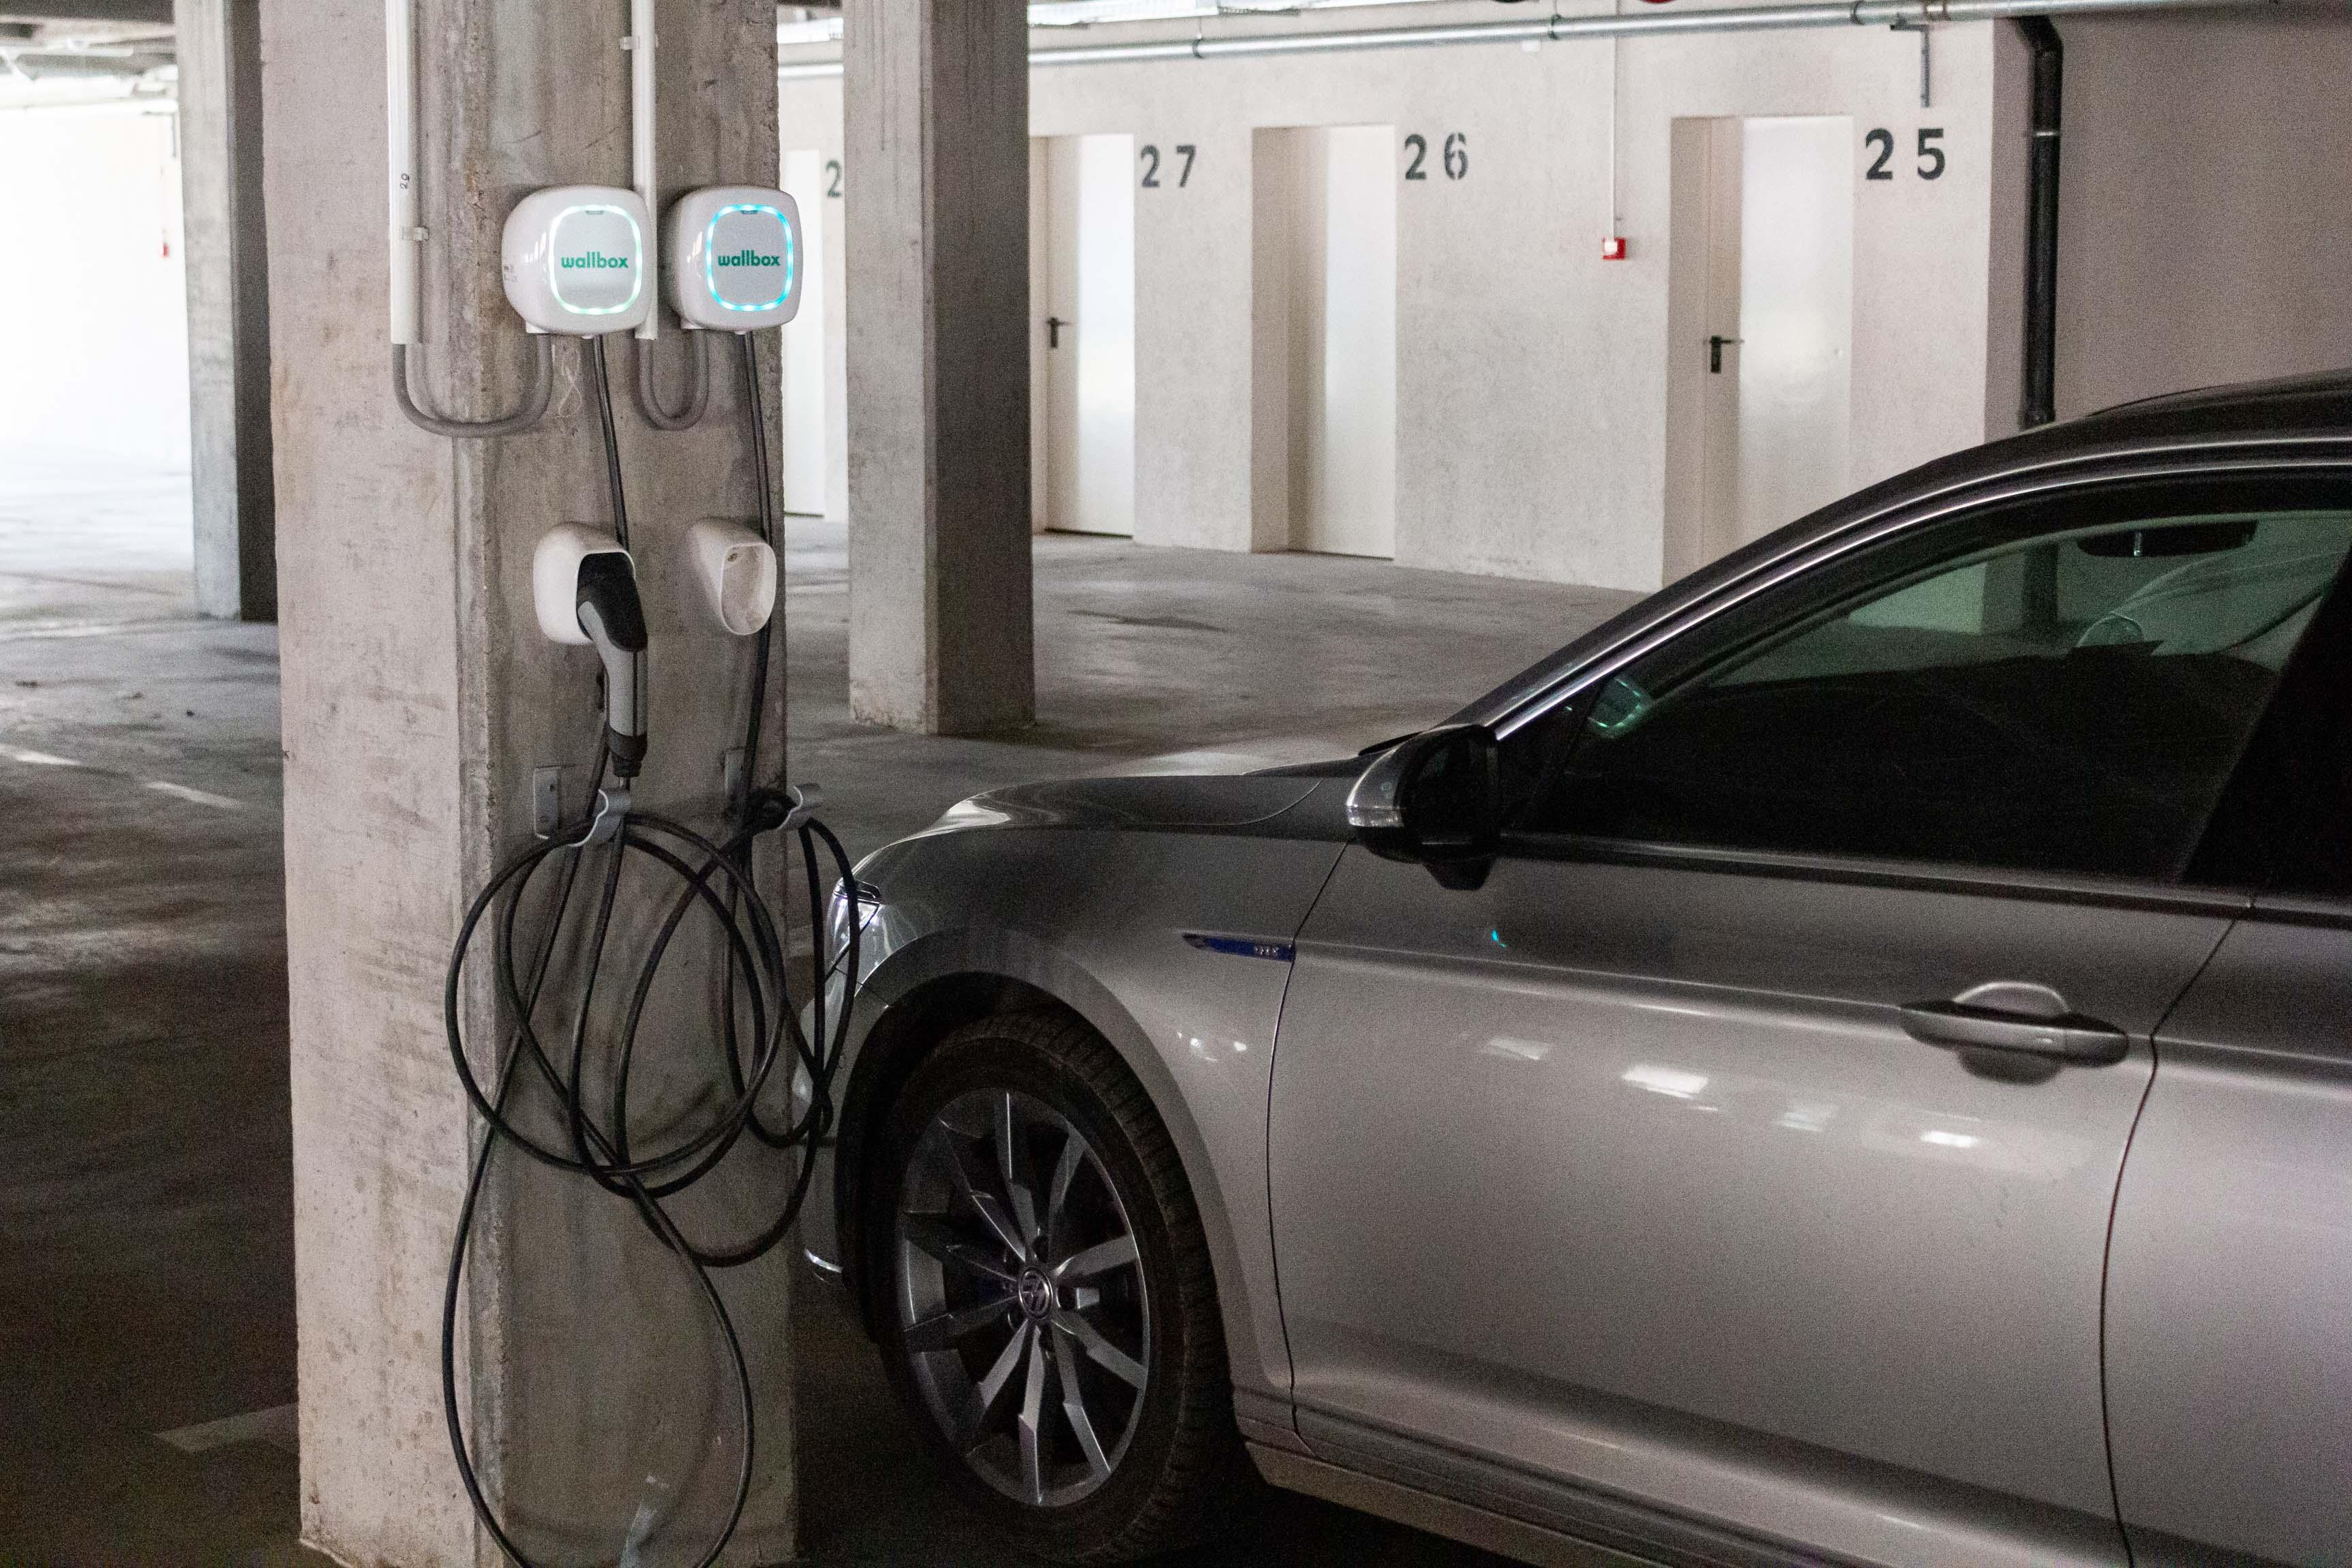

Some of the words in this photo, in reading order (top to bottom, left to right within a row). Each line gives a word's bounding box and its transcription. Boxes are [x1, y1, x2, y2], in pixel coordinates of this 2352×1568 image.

[1140, 144, 1196, 189] 27
[1404, 132, 1468, 181] 26
[1865, 127, 1946, 181] 25
[561, 251, 629, 269] wallbox
[718, 249, 781, 267] wallbox
